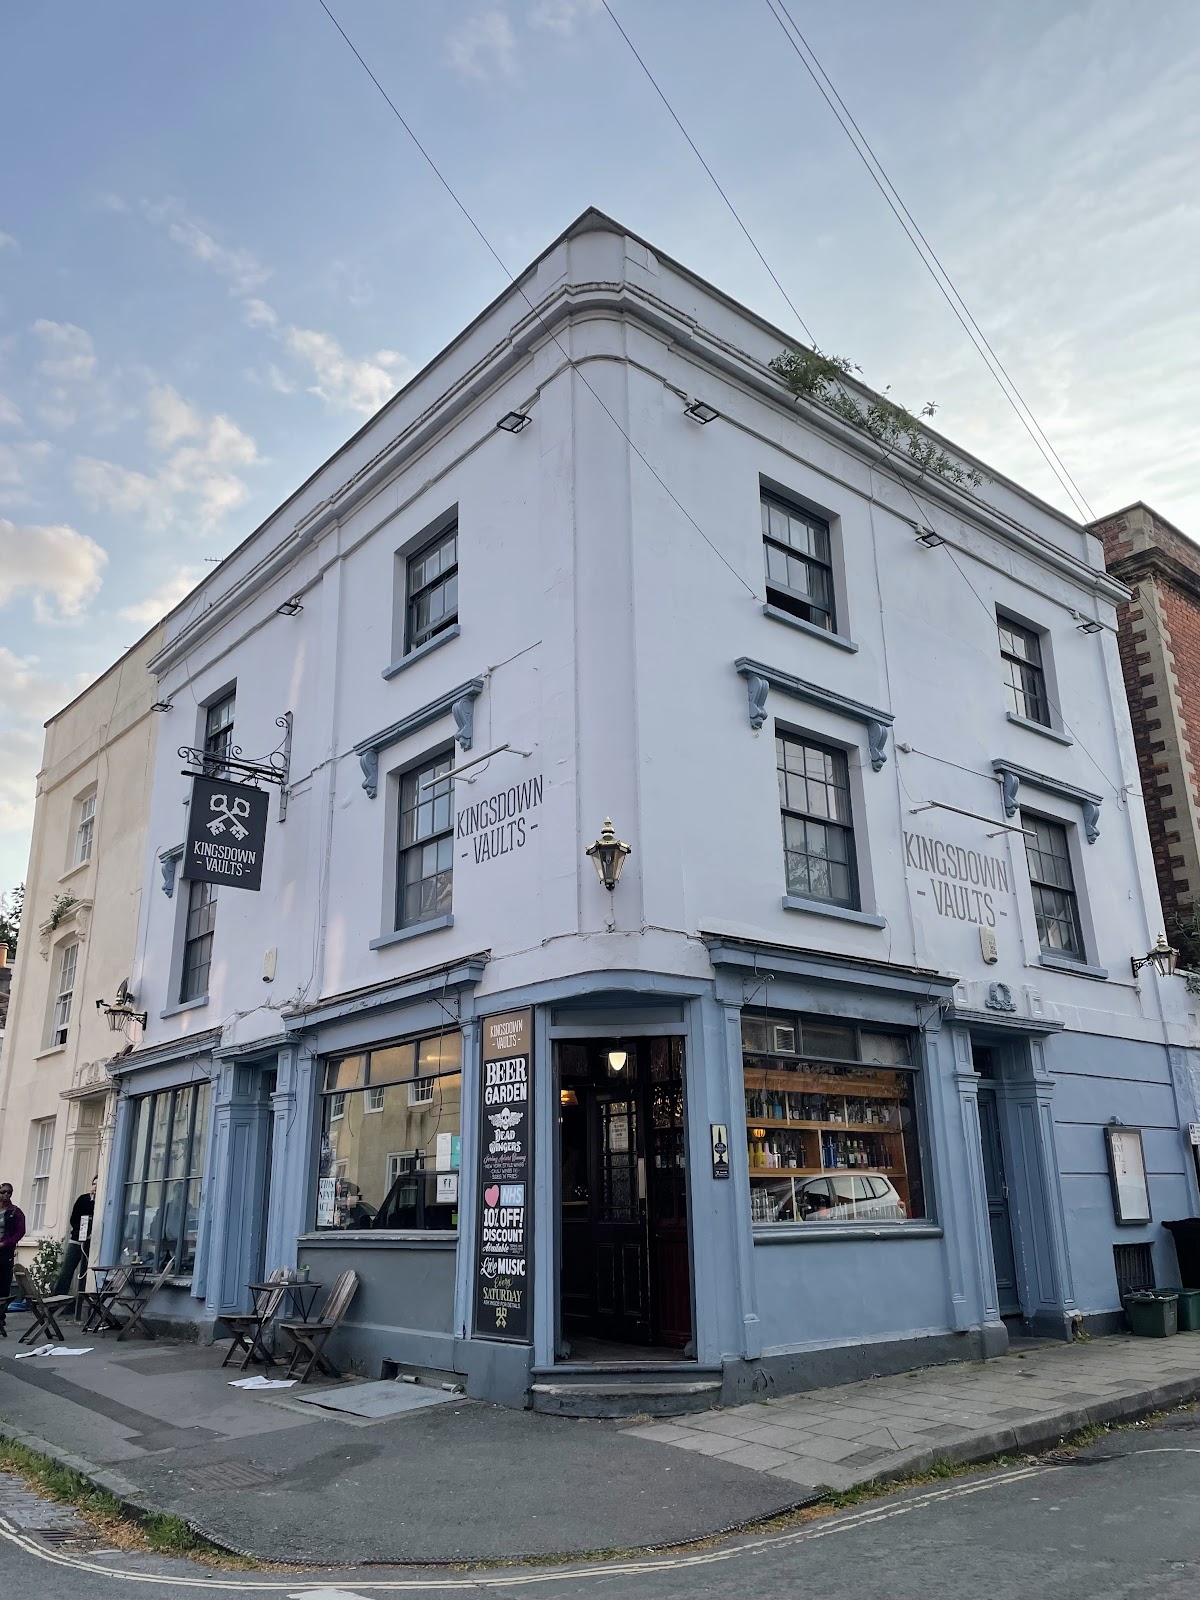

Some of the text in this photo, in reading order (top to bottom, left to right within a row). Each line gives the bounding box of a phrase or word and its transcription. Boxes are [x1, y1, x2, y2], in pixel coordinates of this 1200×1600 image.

[457, 774, 543, 840] KINGSDOWN
[473, 816, 526, 864] VAULTS
[193, 840, 256, 865] KINGSDOWN
[903, 831, 1009, 893] KINGSDOWN
[205, 856, 243, 876] VAULTS
[930, 878, 996, 928] VAULTS
[490, 1019, 523, 1038] KINGSDOWN
[496, 1034, 517, 1050] VAULTS
[485, 1058, 527, 1086] BEER
[485, 1082, 527, 1105] GARDEN
[494, 1129, 516, 1142] DEAD
[502, 1187, 522, 1203] NHS
[484, 1207, 524, 1228] 10% OFF!
[483, 1228, 523, 1242] DISCOUNT
[480, 1257, 525, 1278] Live MUSIC
[494, 1276, 513, 1289] Every
[483, 1286, 522, 1302] SATURDAY
